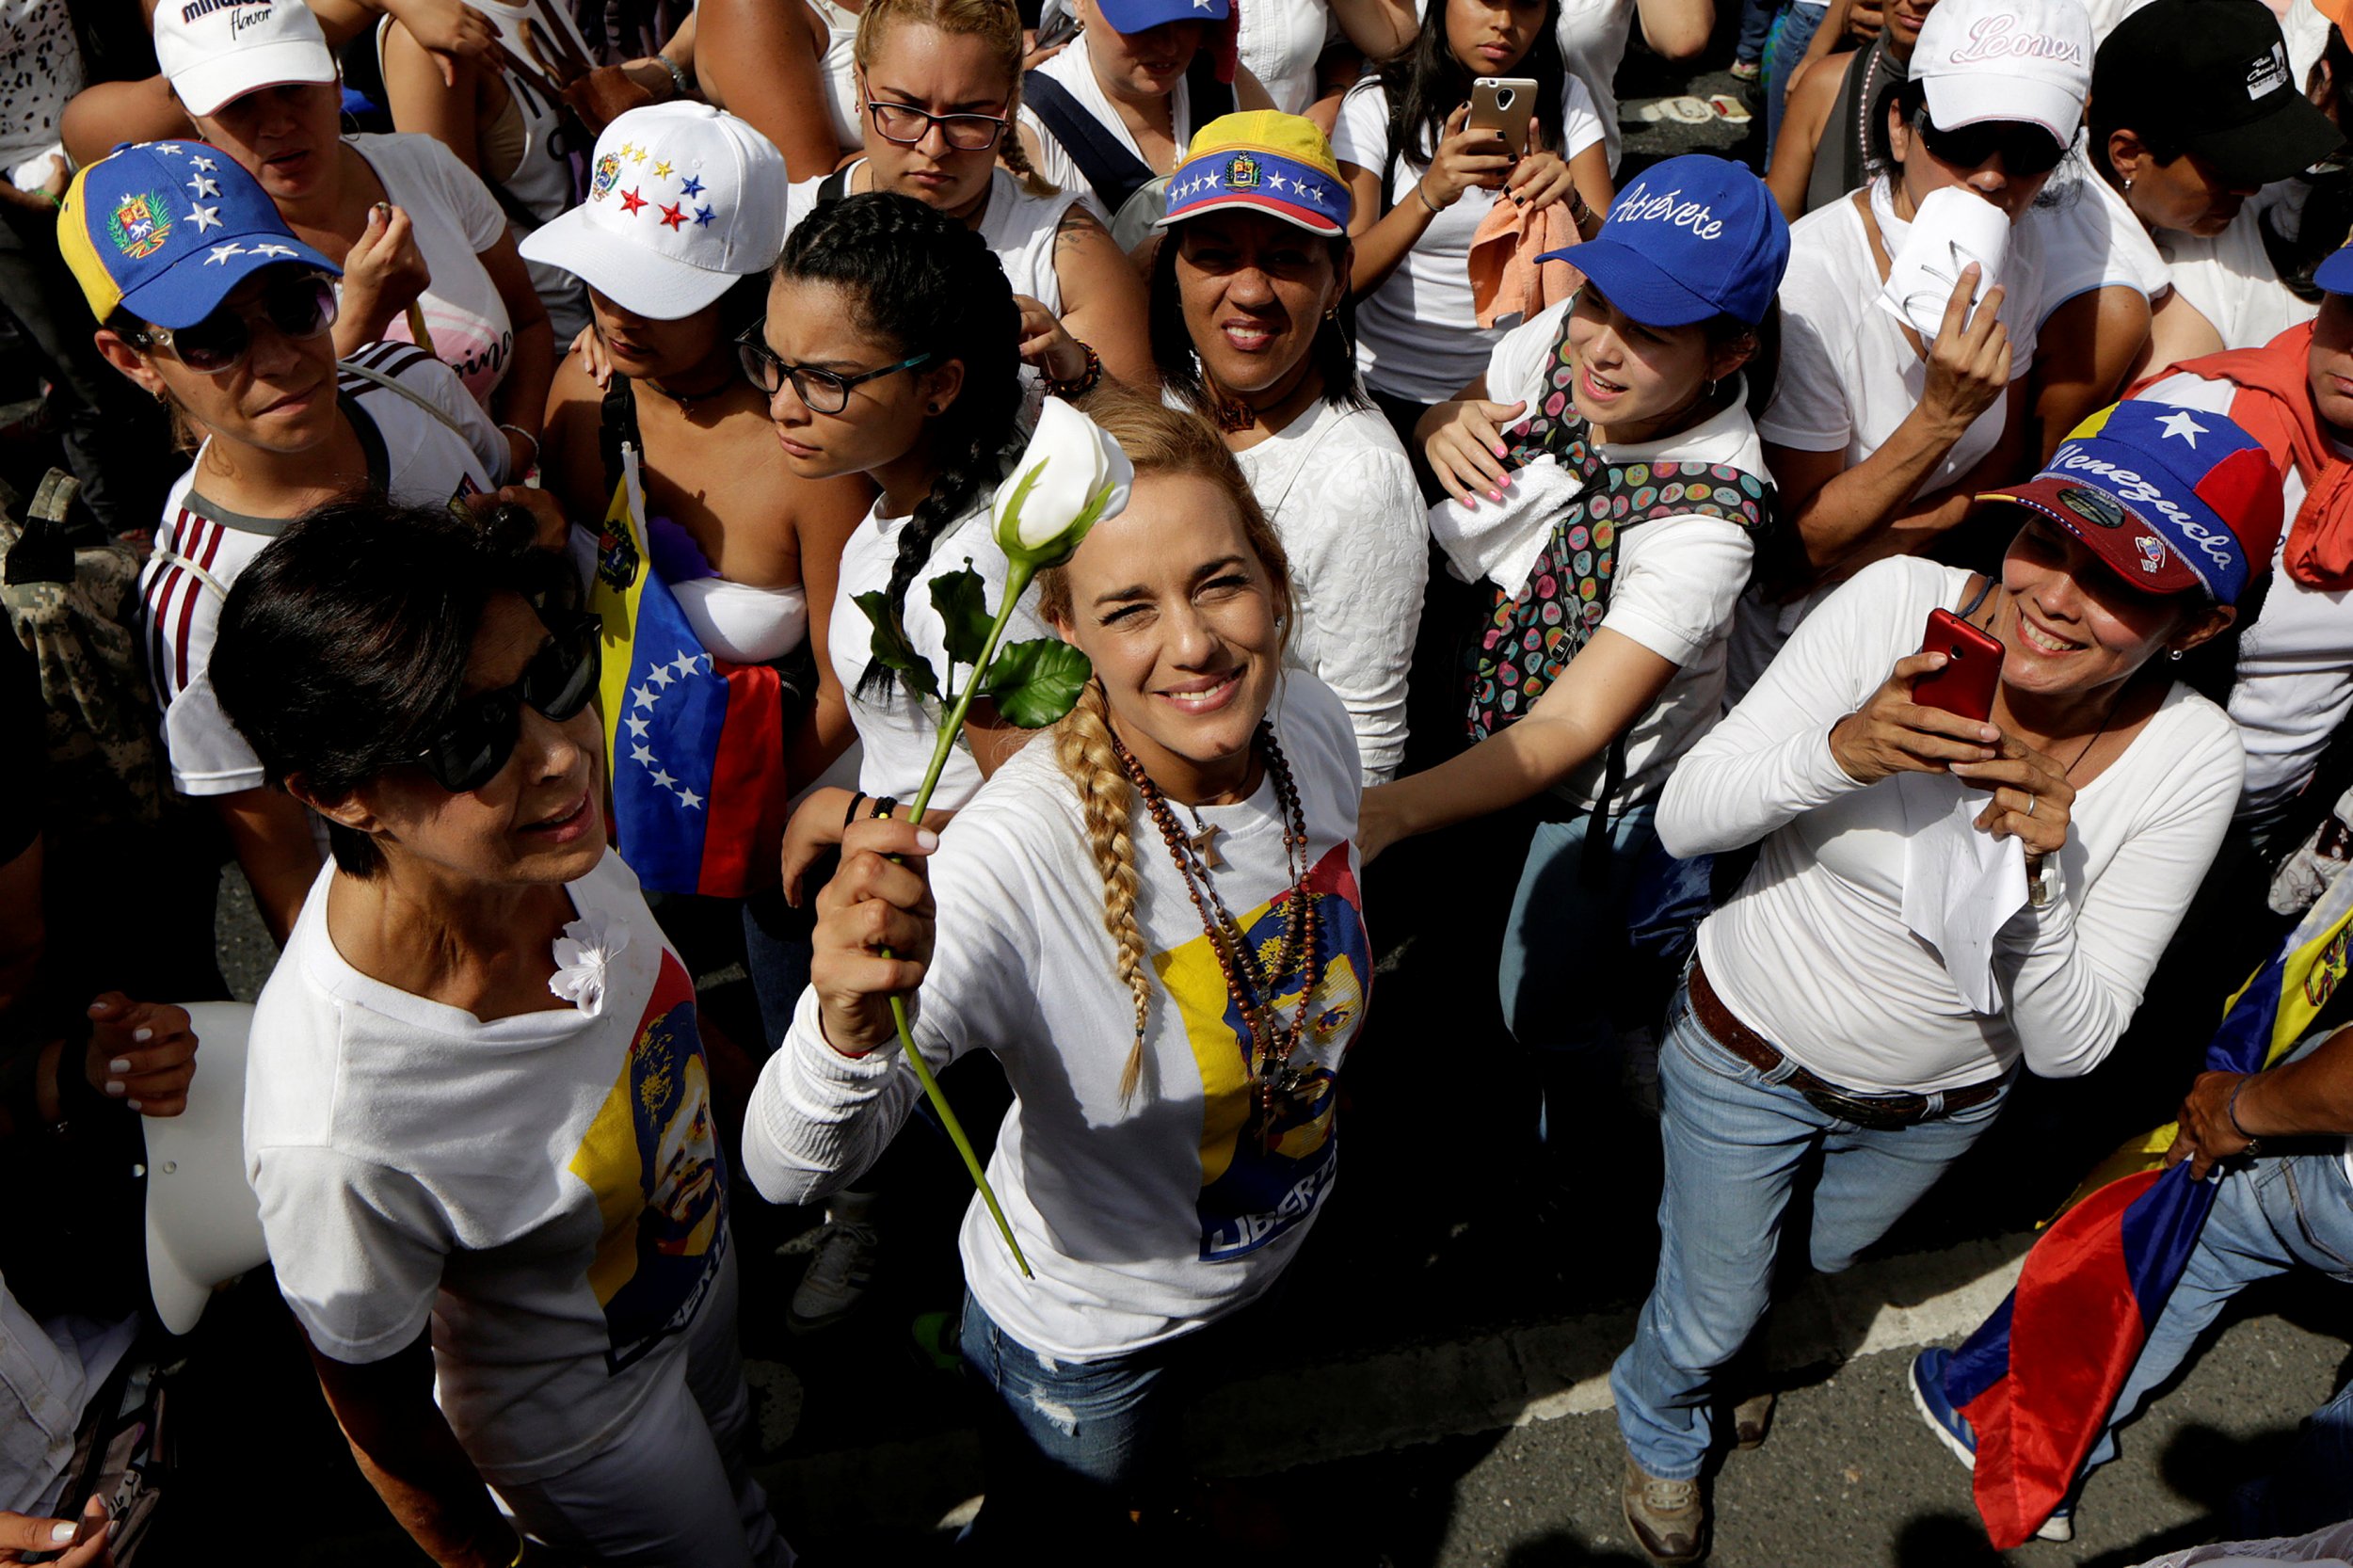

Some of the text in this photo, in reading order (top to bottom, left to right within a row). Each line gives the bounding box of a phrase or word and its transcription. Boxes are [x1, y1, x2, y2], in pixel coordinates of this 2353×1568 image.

[231, 8, 272, 40] flavor
[1949, 14, 2082, 67] Leones
[1607, 182, 1723, 240] Atrévete
[2050, 443, 2233, 571] Venezuela
